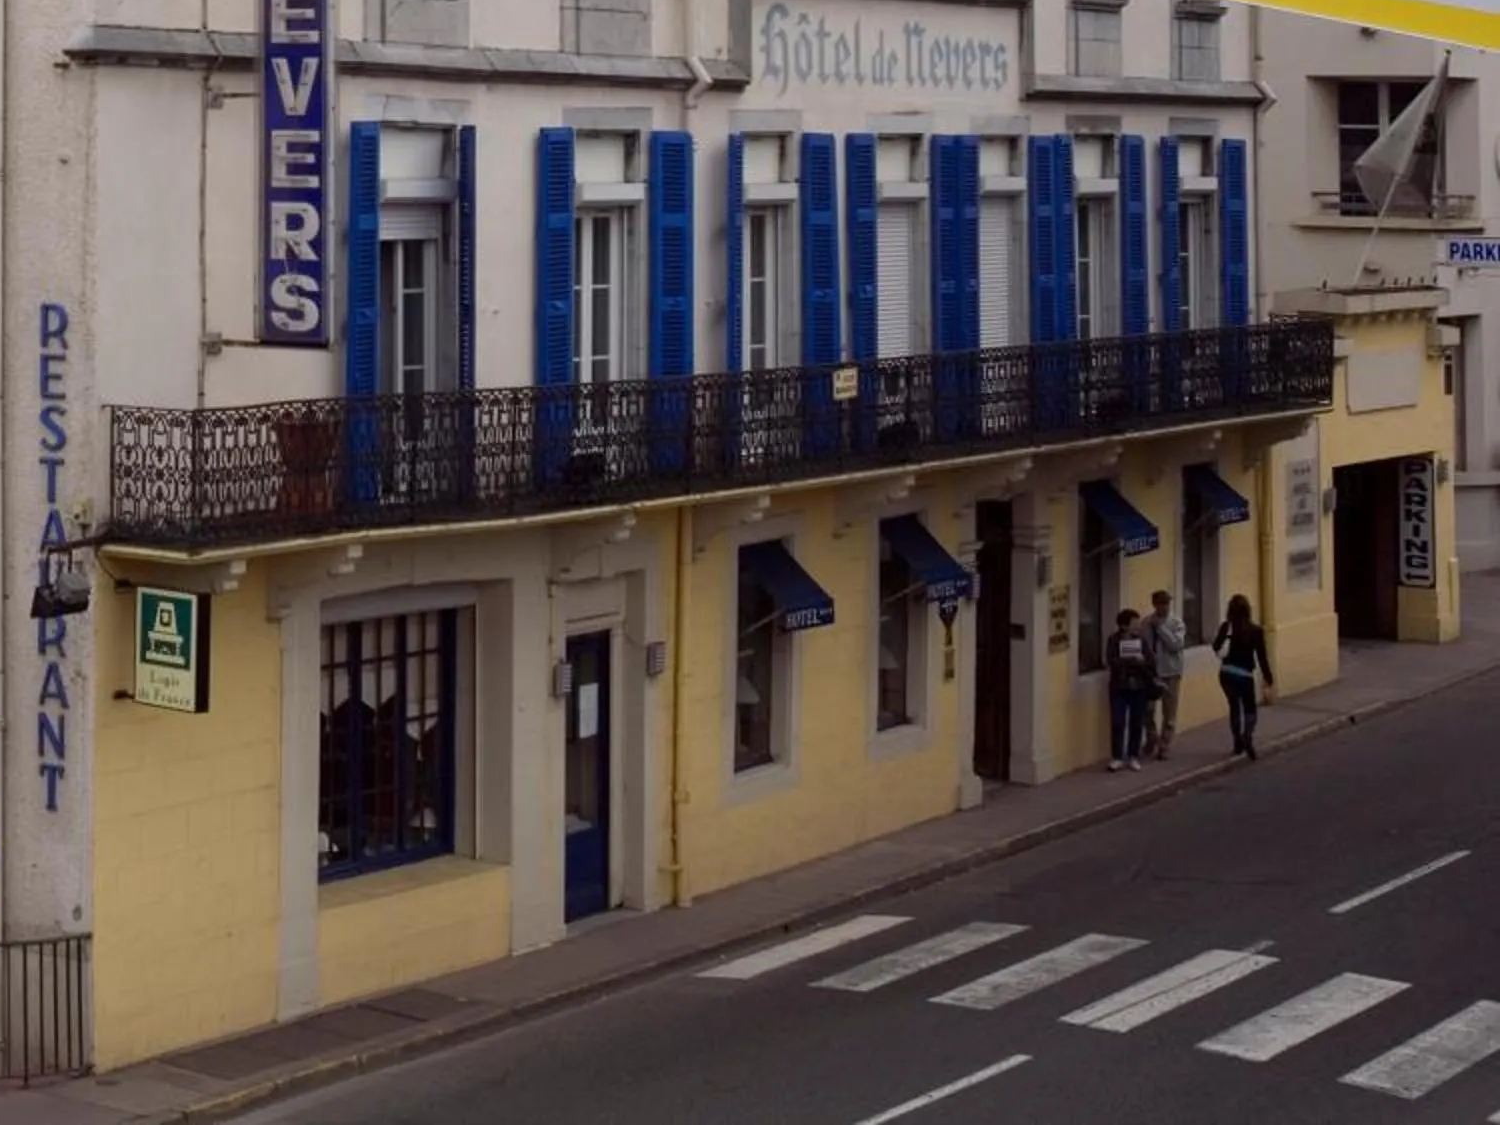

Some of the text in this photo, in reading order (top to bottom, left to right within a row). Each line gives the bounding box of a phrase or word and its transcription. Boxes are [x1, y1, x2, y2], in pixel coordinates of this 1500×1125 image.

[760, 2, 1009, 98] Hôtel de Nevers
[1404, 459, 1428, 569] PARKING
[786, 608, 821, 629] HOTEL
